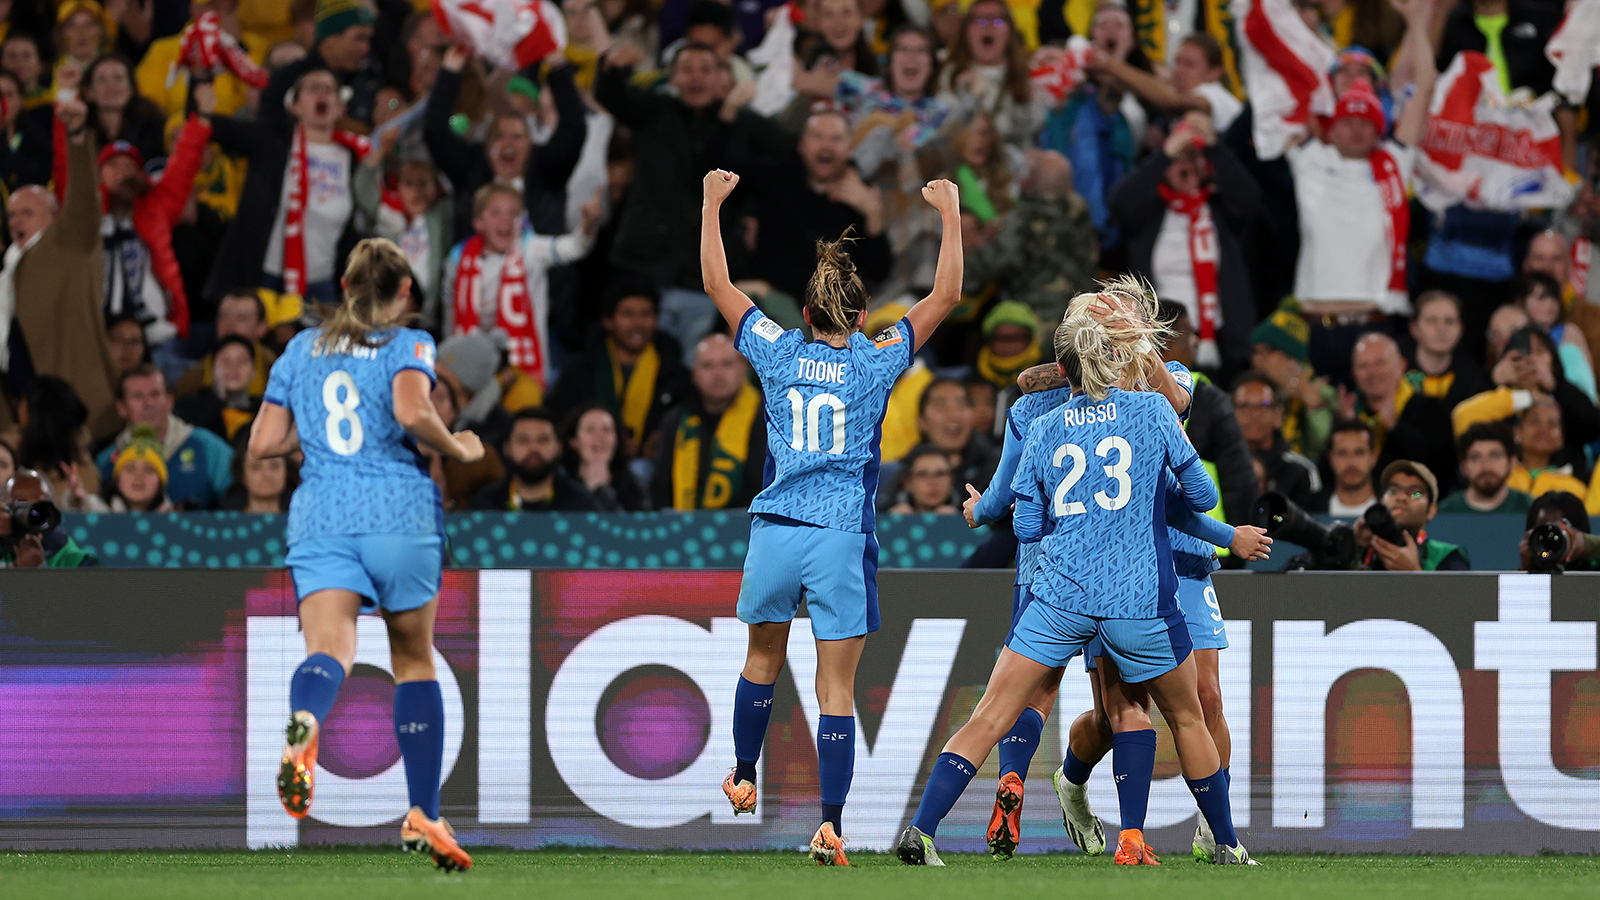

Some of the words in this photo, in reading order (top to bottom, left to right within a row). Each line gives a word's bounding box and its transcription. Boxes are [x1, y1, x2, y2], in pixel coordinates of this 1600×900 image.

[798, 358, 847, 384] TOONE
[322, 370, 364, 456] 8
[786, 387, 846, 455] 10
[1064, 402, 1117, 428] RUSSO
[1052, 436, 1132, 517] 23
[1203, 585, 1222, 622] 9
